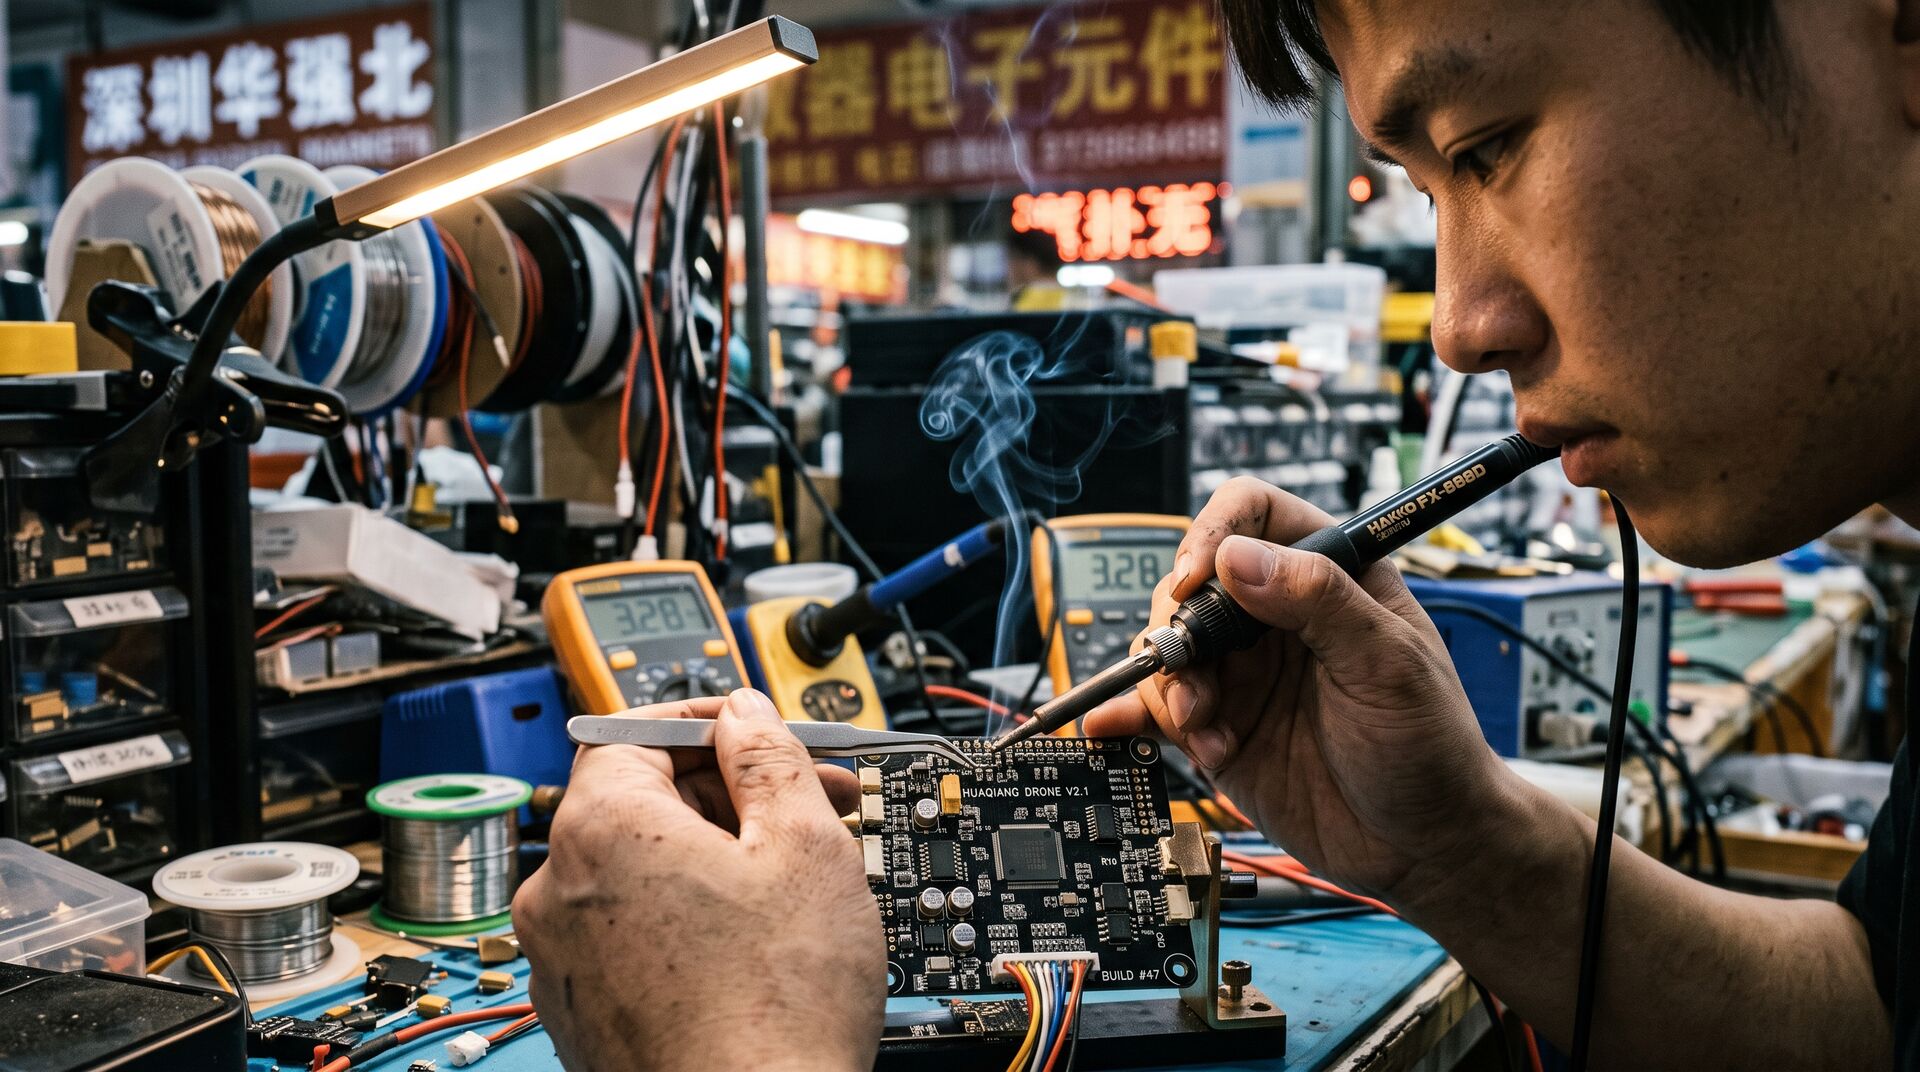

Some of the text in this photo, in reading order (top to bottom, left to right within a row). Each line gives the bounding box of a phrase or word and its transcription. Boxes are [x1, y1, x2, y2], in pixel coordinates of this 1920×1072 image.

[82, 20, 434, 153] 深圳华强北
[764, 5, 1224, 141] 器电子元件
[1366, 501, 1418, 536] HAKKO
[1416, 463, 1487, 510] FX-888D
[962, 786, 1089, 798] HUAQIANG DRONE V2.1
[1102, 970, 1160, 981] BUILD #47
